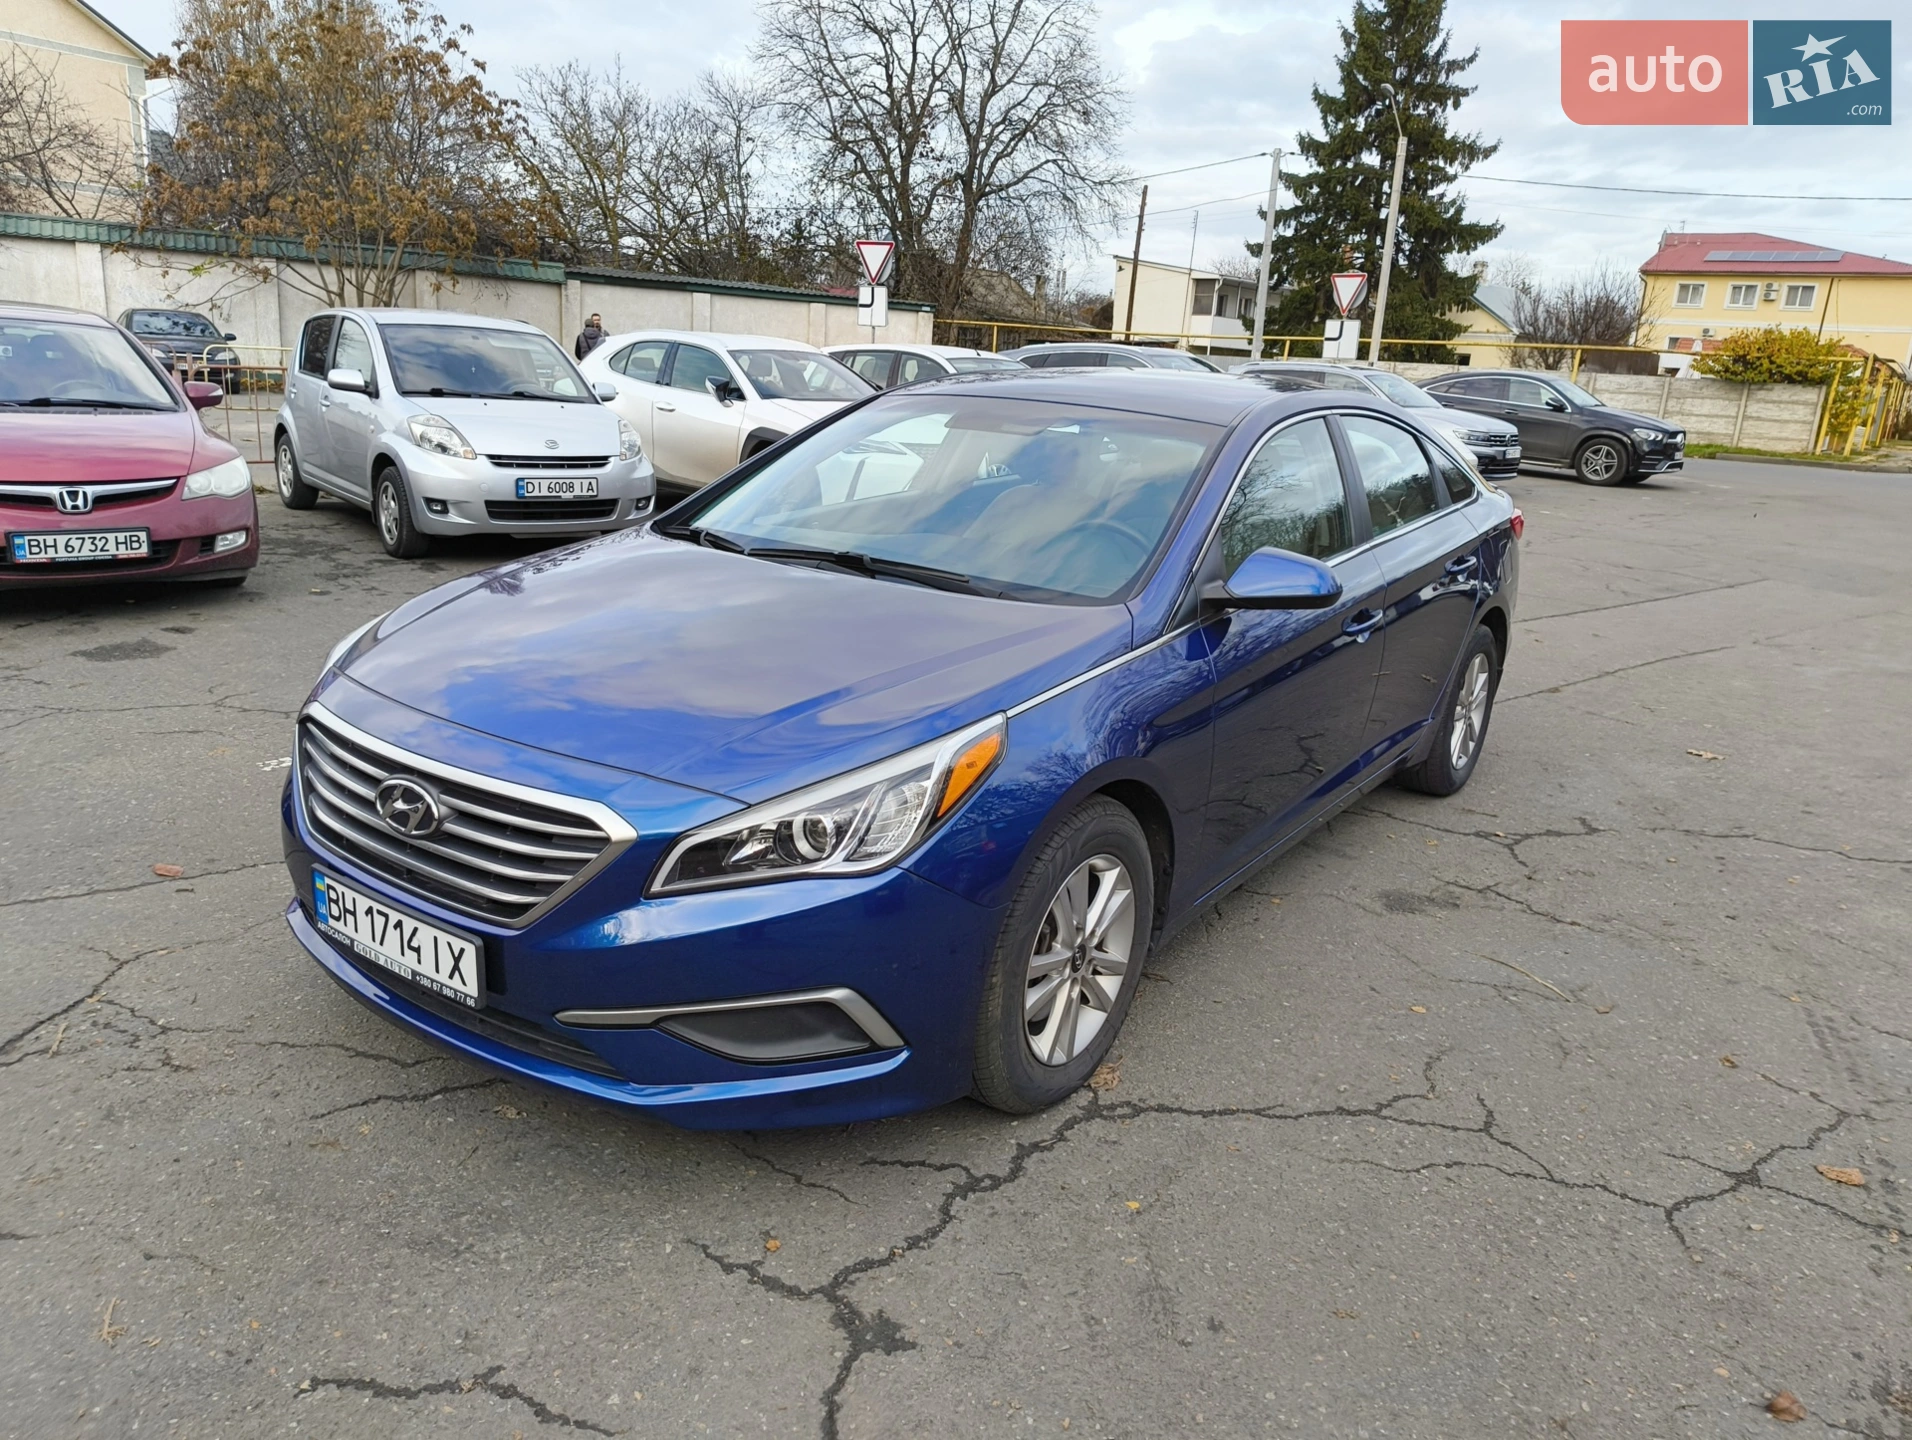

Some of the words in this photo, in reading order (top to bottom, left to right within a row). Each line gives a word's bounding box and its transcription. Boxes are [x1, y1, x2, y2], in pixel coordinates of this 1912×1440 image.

[526, 481, 541, 494] DI
[547, 481, 575, 494] 6008
[580, 481, 595, 493] IA
[27, 538, 59, 556] BH
[64, 536, 110, 554] 6732
[114, 534, 143, 552] HB
[317, 901, 328, 915] UA
[317, 921, 352, 946] АВТОСАЛОН
[326, 883, 358, 934] BH
[364, 905, 422, 966] 1714
[433, 935, 468, 987] IX
[355, 942, 380, 963] GOLD
[383, 957, 411, 979] AUTO
[415, 974, 432, 988] +380
[432, 981, 441, 992] 67
[442, 985, 455, 999] 980
[456, 991, 465, 1002] 77
[466, 996, 475, 1007] 66
